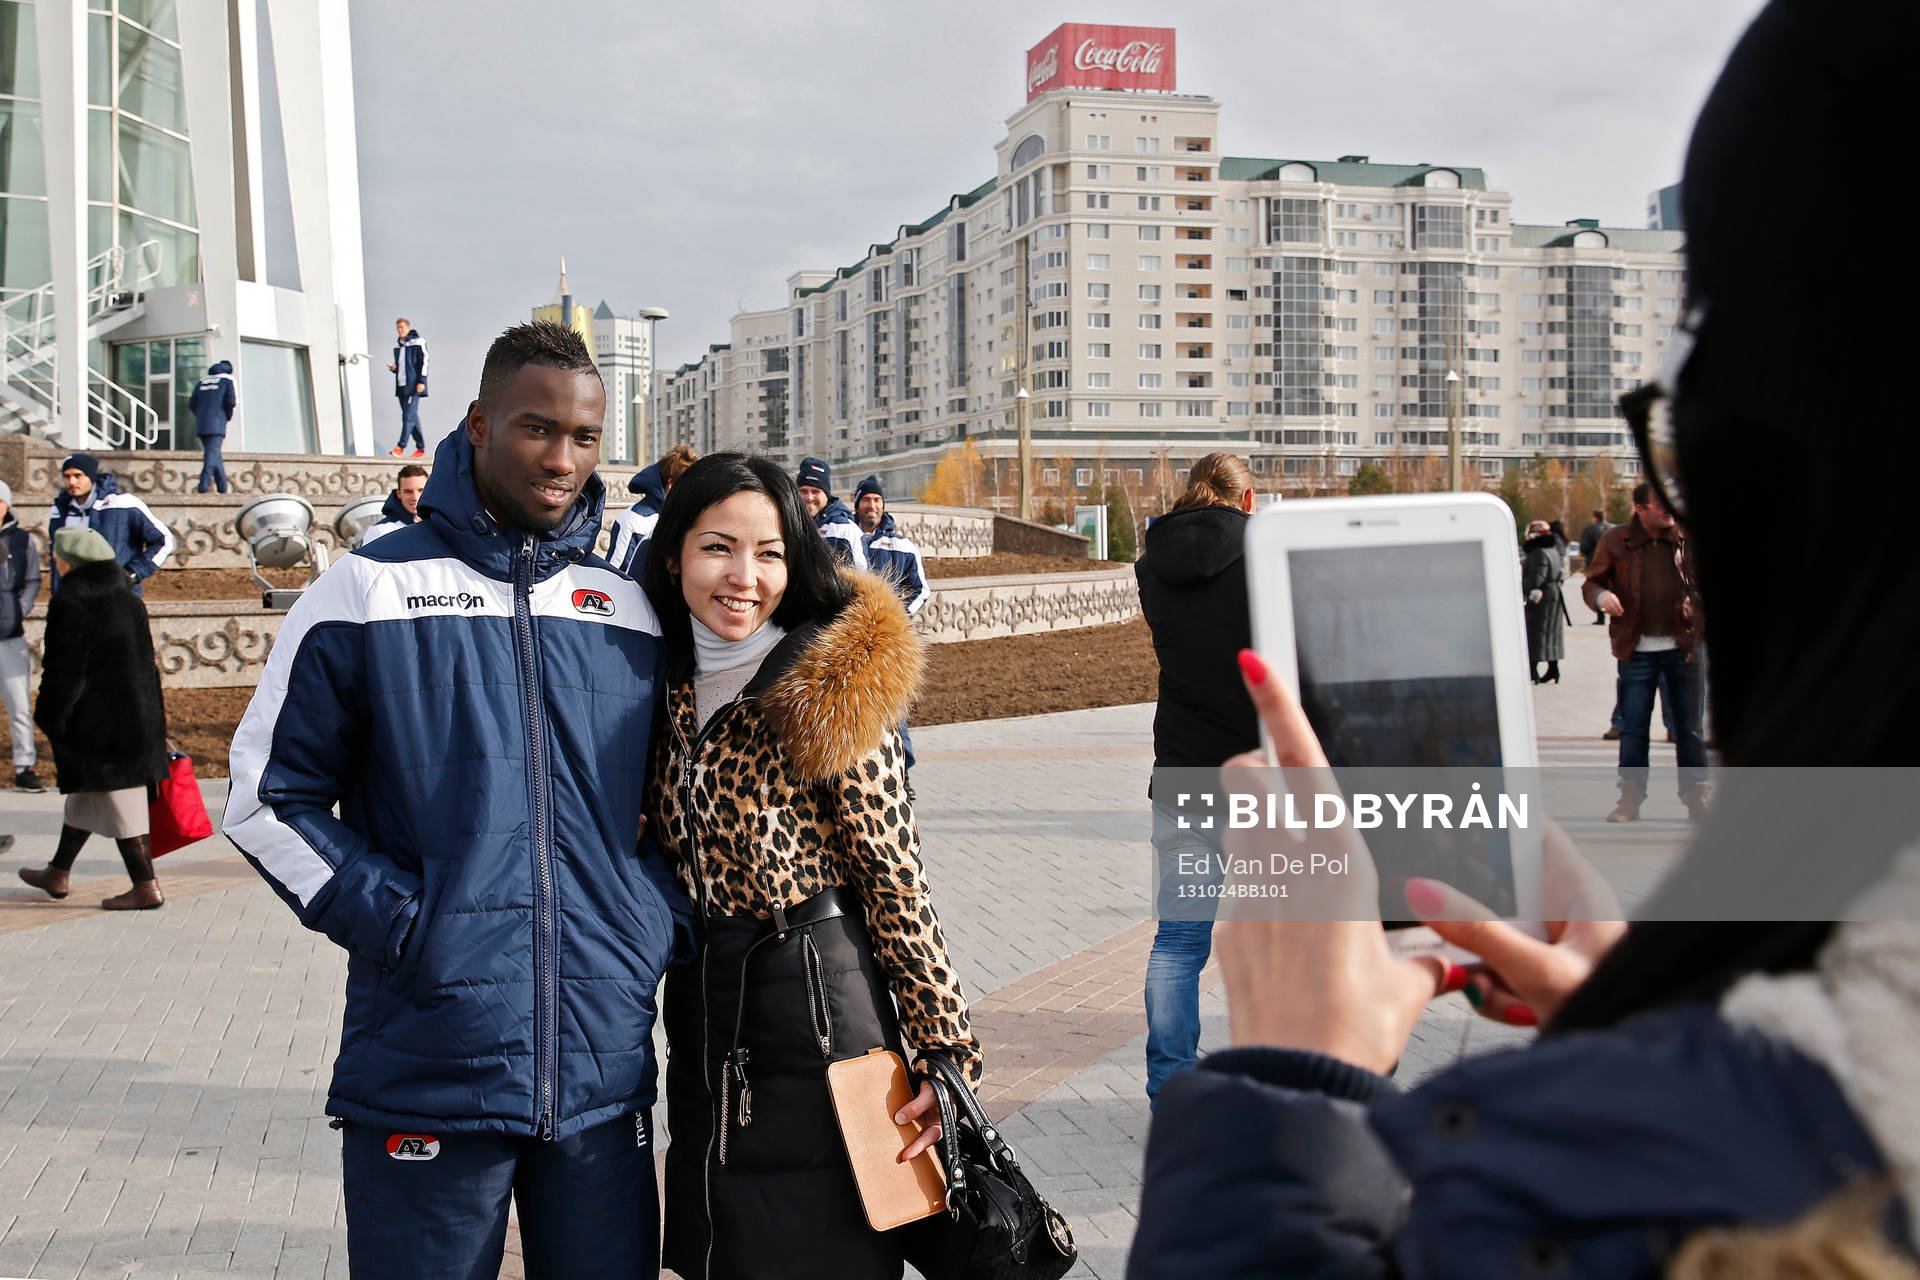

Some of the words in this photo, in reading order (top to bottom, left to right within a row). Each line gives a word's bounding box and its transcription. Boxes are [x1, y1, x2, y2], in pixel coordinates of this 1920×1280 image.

[406, 592, 485, 610] macron
[581, 594, 610, 612] AZ
[395, 1138, 432, 1157] AZ
